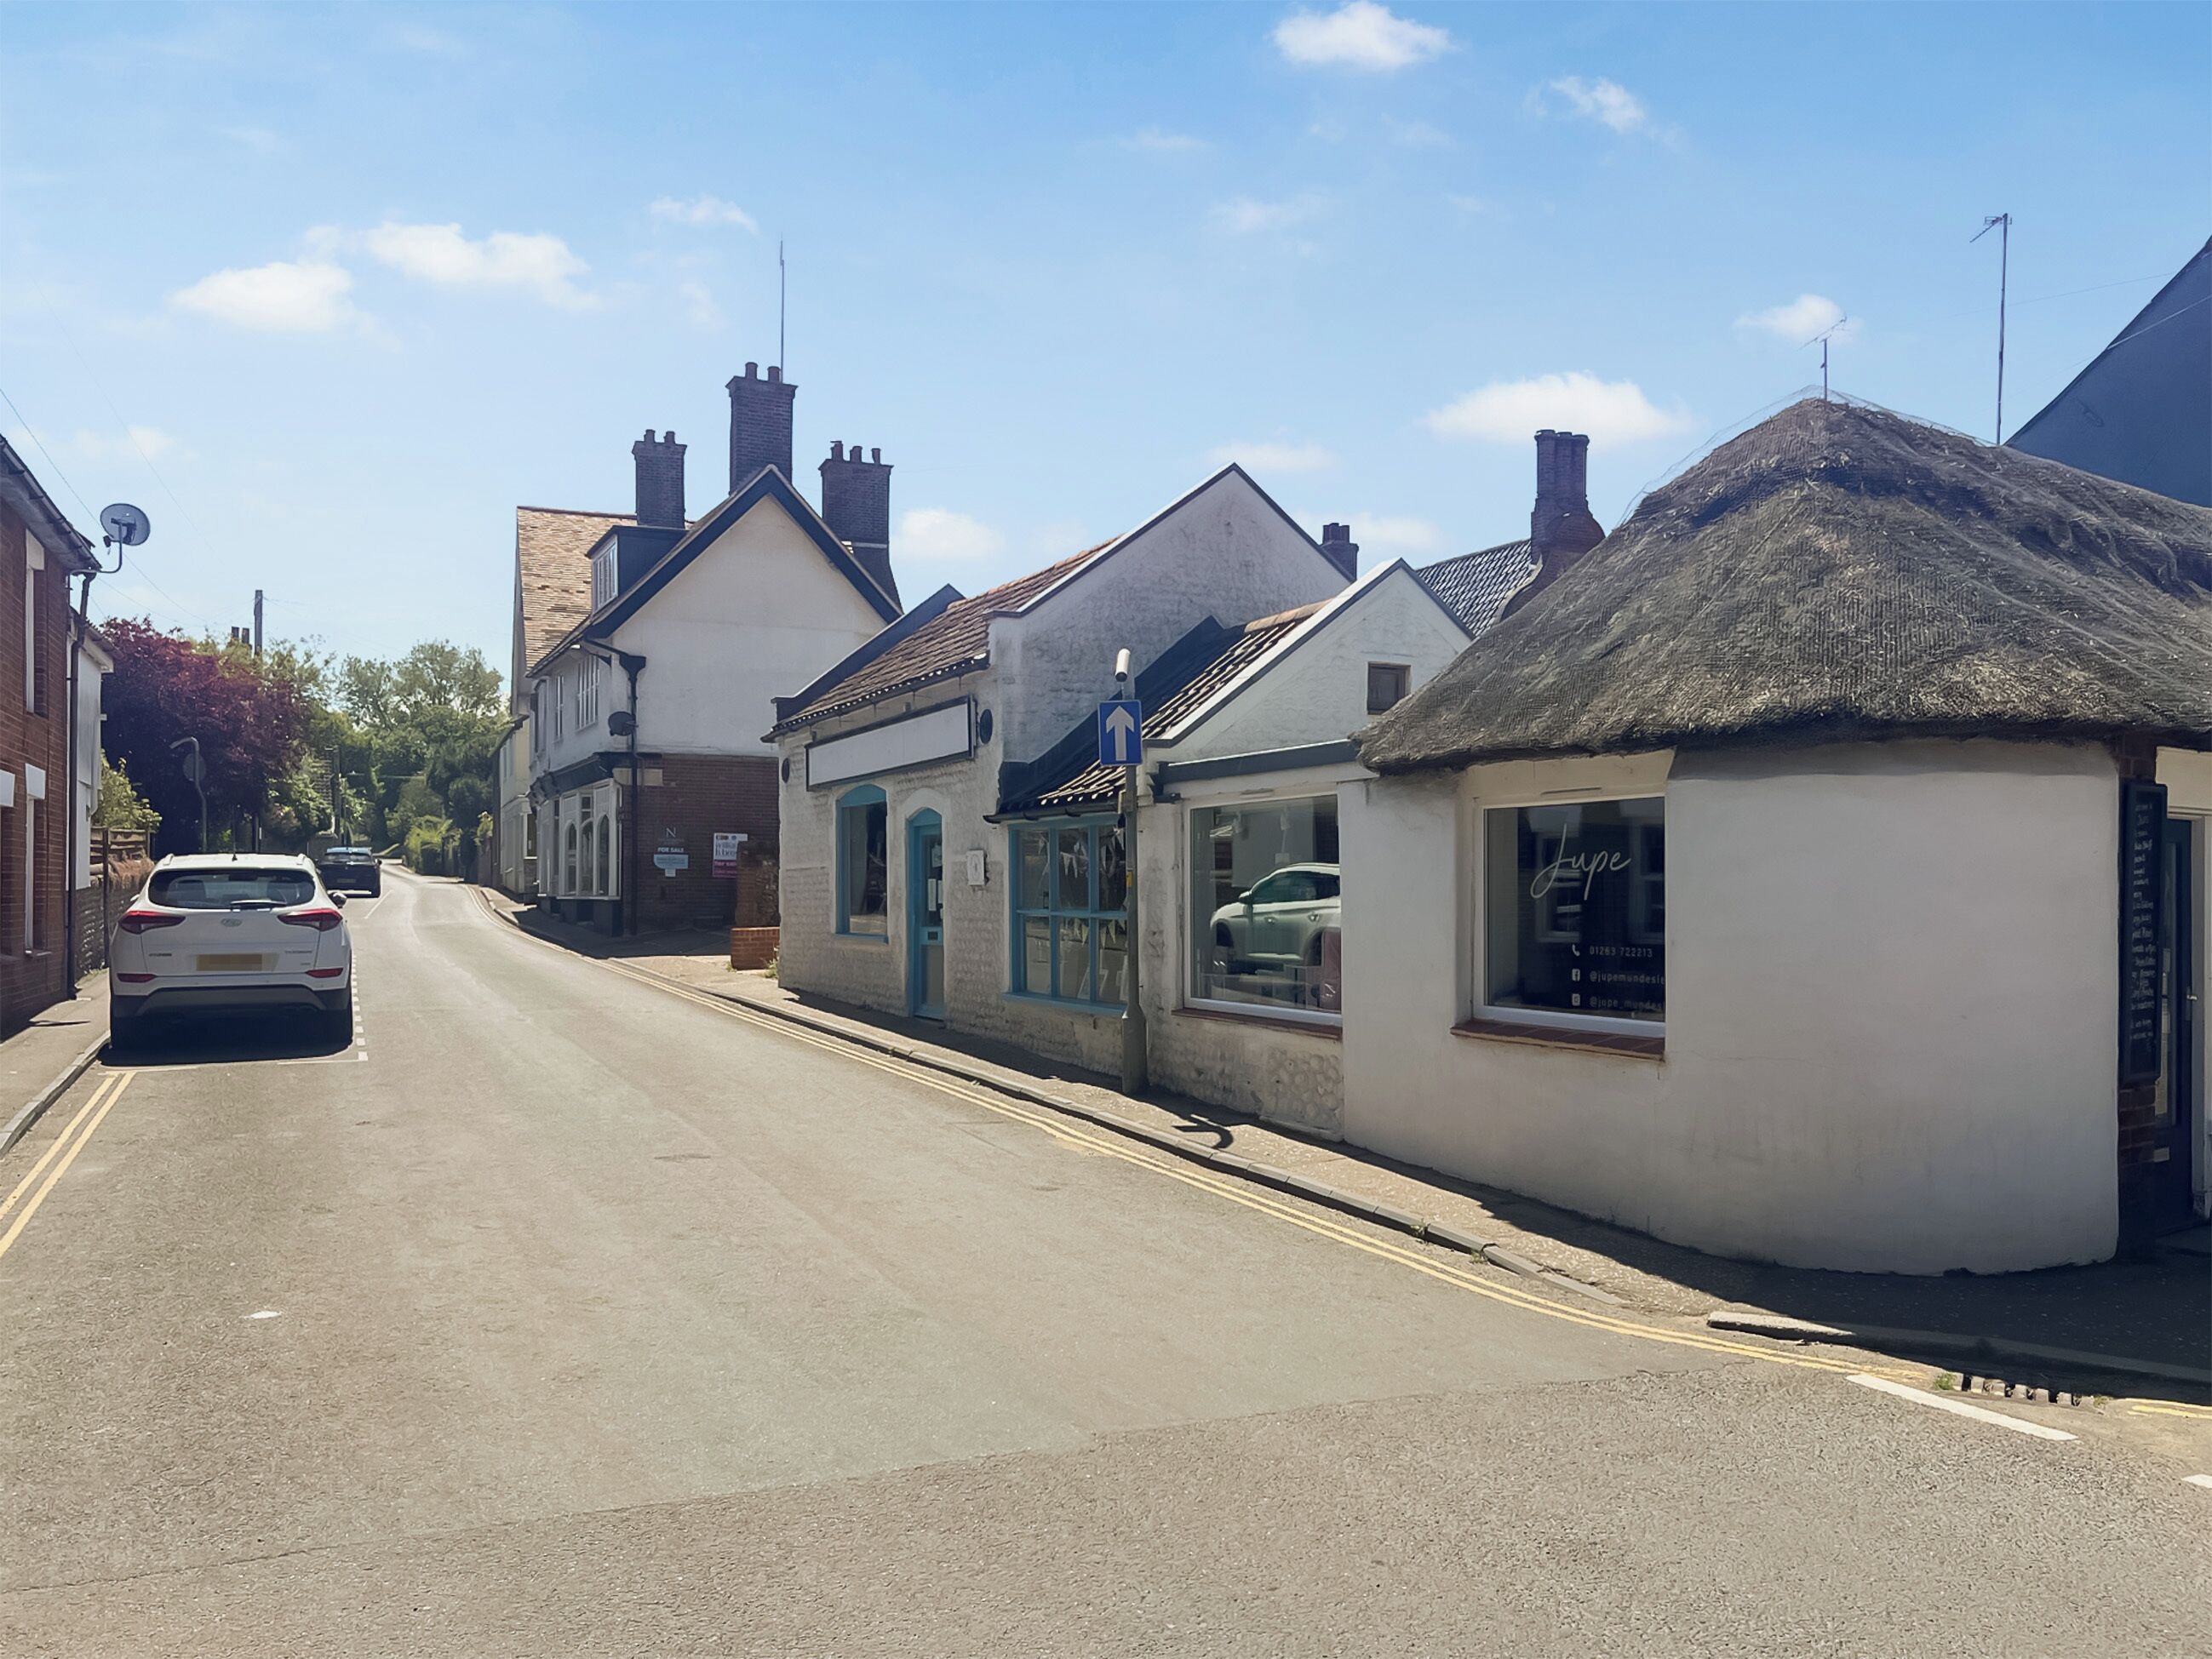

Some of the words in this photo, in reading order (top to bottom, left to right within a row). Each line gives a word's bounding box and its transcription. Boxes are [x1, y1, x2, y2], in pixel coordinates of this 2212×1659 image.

[1530, 823, 1631, 901] Jupe
[1589, 946, 1616, 956] 01263
[1620, 947, 1653, 958] 722213
